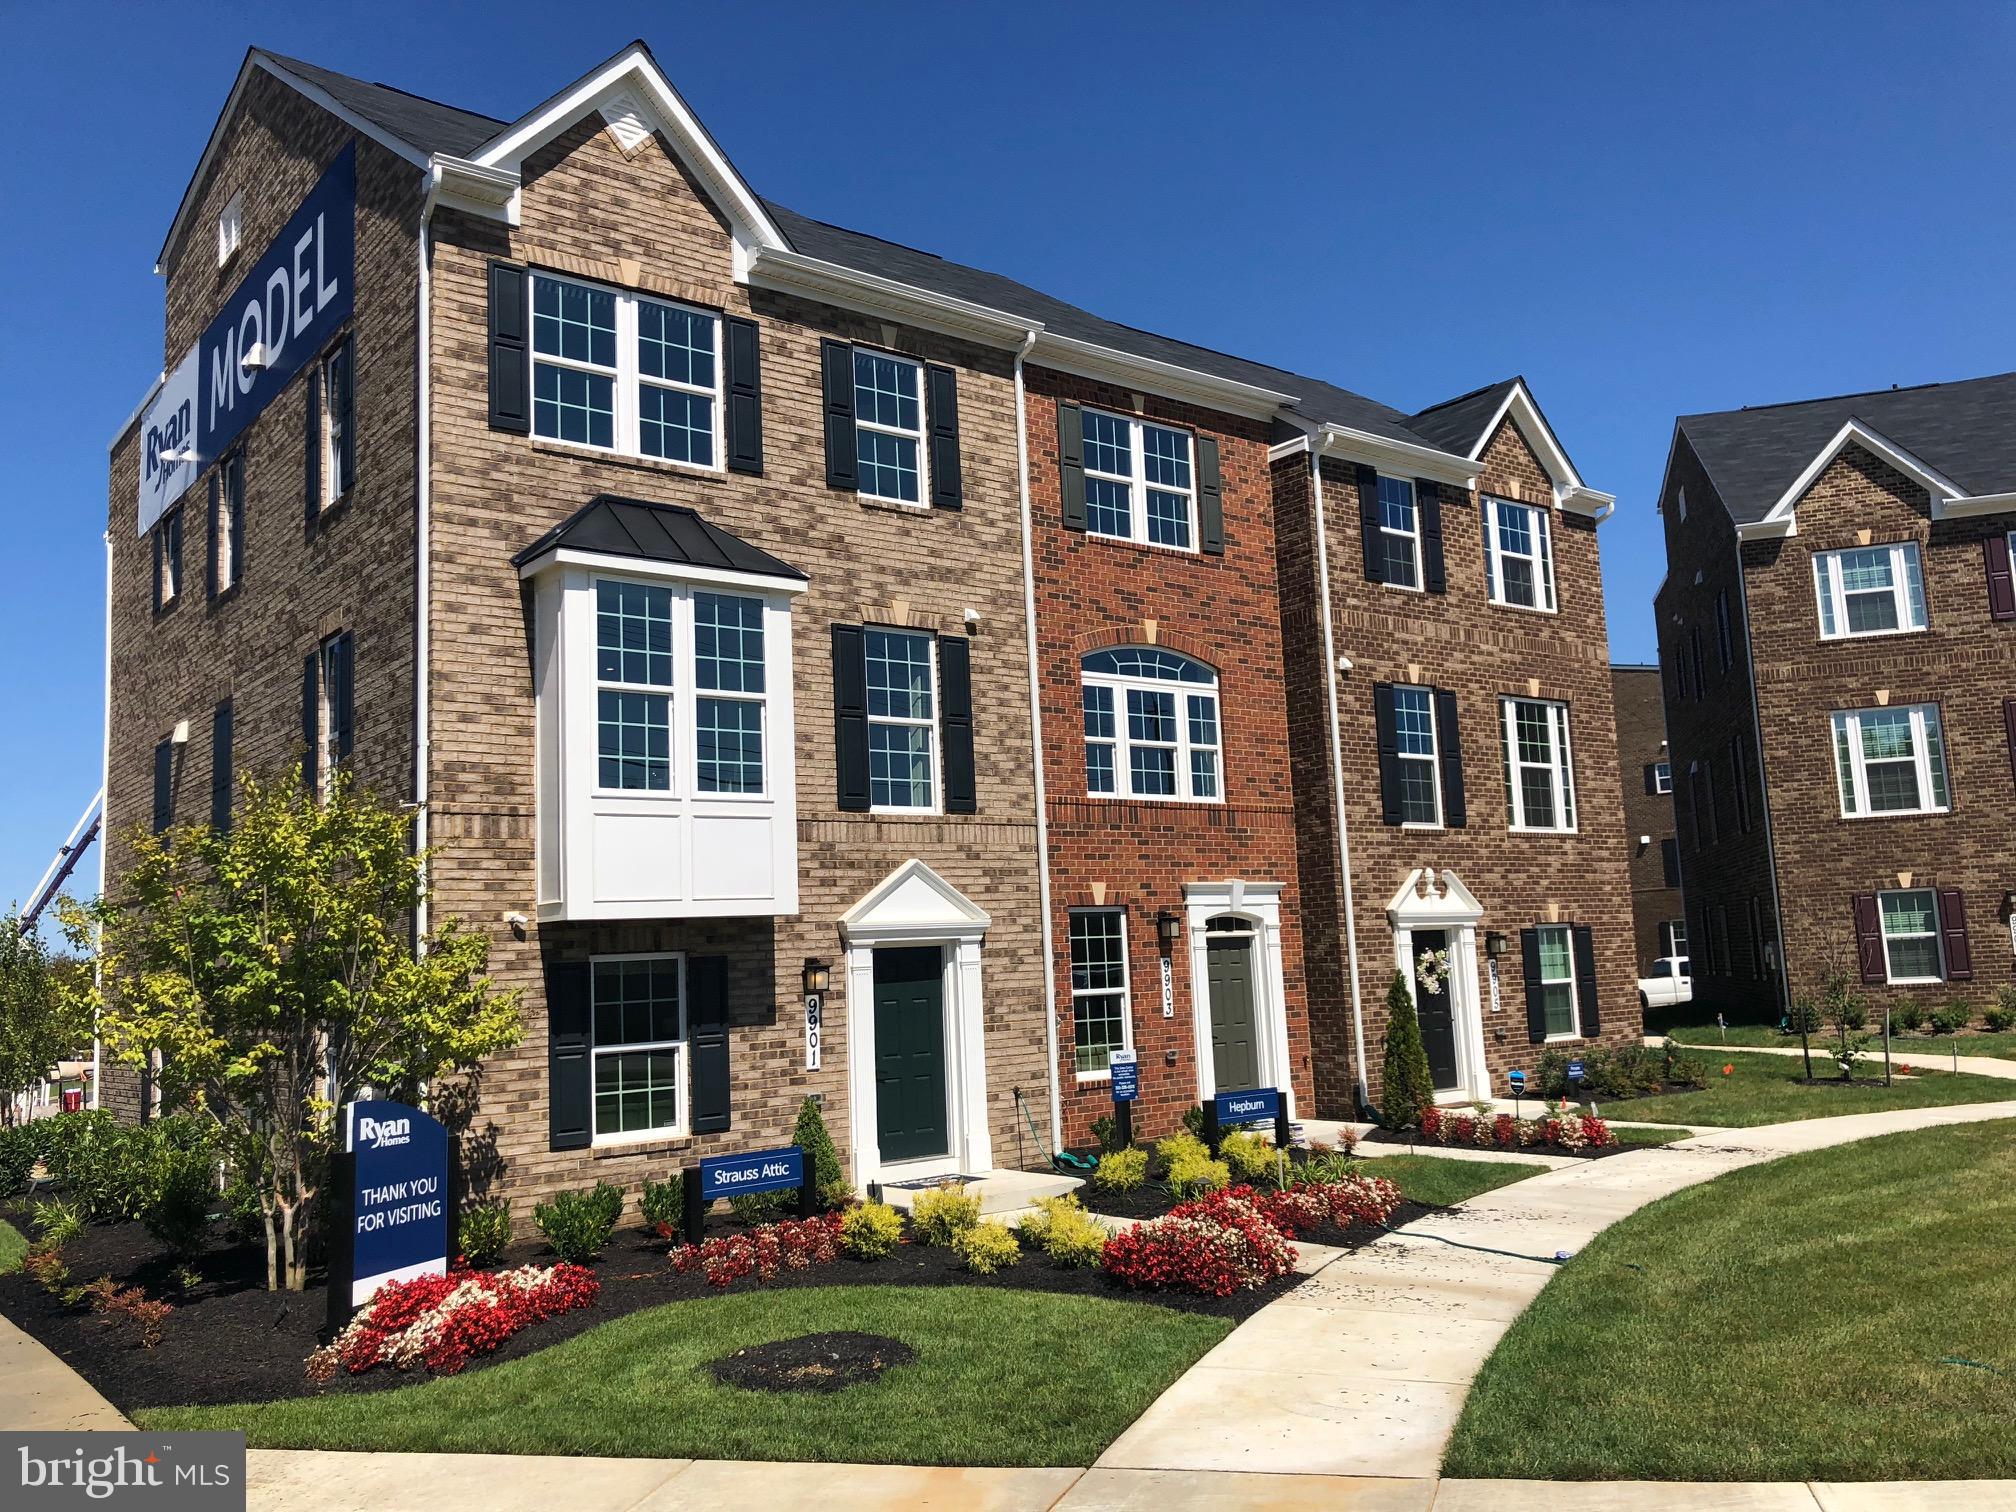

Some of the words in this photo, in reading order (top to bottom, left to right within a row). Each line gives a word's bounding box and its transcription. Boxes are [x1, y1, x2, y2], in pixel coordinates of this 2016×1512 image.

[209, 212, 338, 433] MODEL
[145, 398, 191, 494] Ryan
[1163, 959, 1172, 1015] 9903
[808, 998, 819, 1066] 9901
[1229, 1100, 1265, 1113] Hepburn
[359, 1117, 411, 1148] Ryan
[380, 1135, 411, 1148] Homes
[714, 1166, 759, 1185] Strauss
[761, 1158, 790, 1178] Attic
[361, 1181, 408, 1206] THANK
[410, 1176, 438, 1196] YOU
[357, 1212, 385, 1234] FOR
[387, 1200, 441, 1226] VISITING
